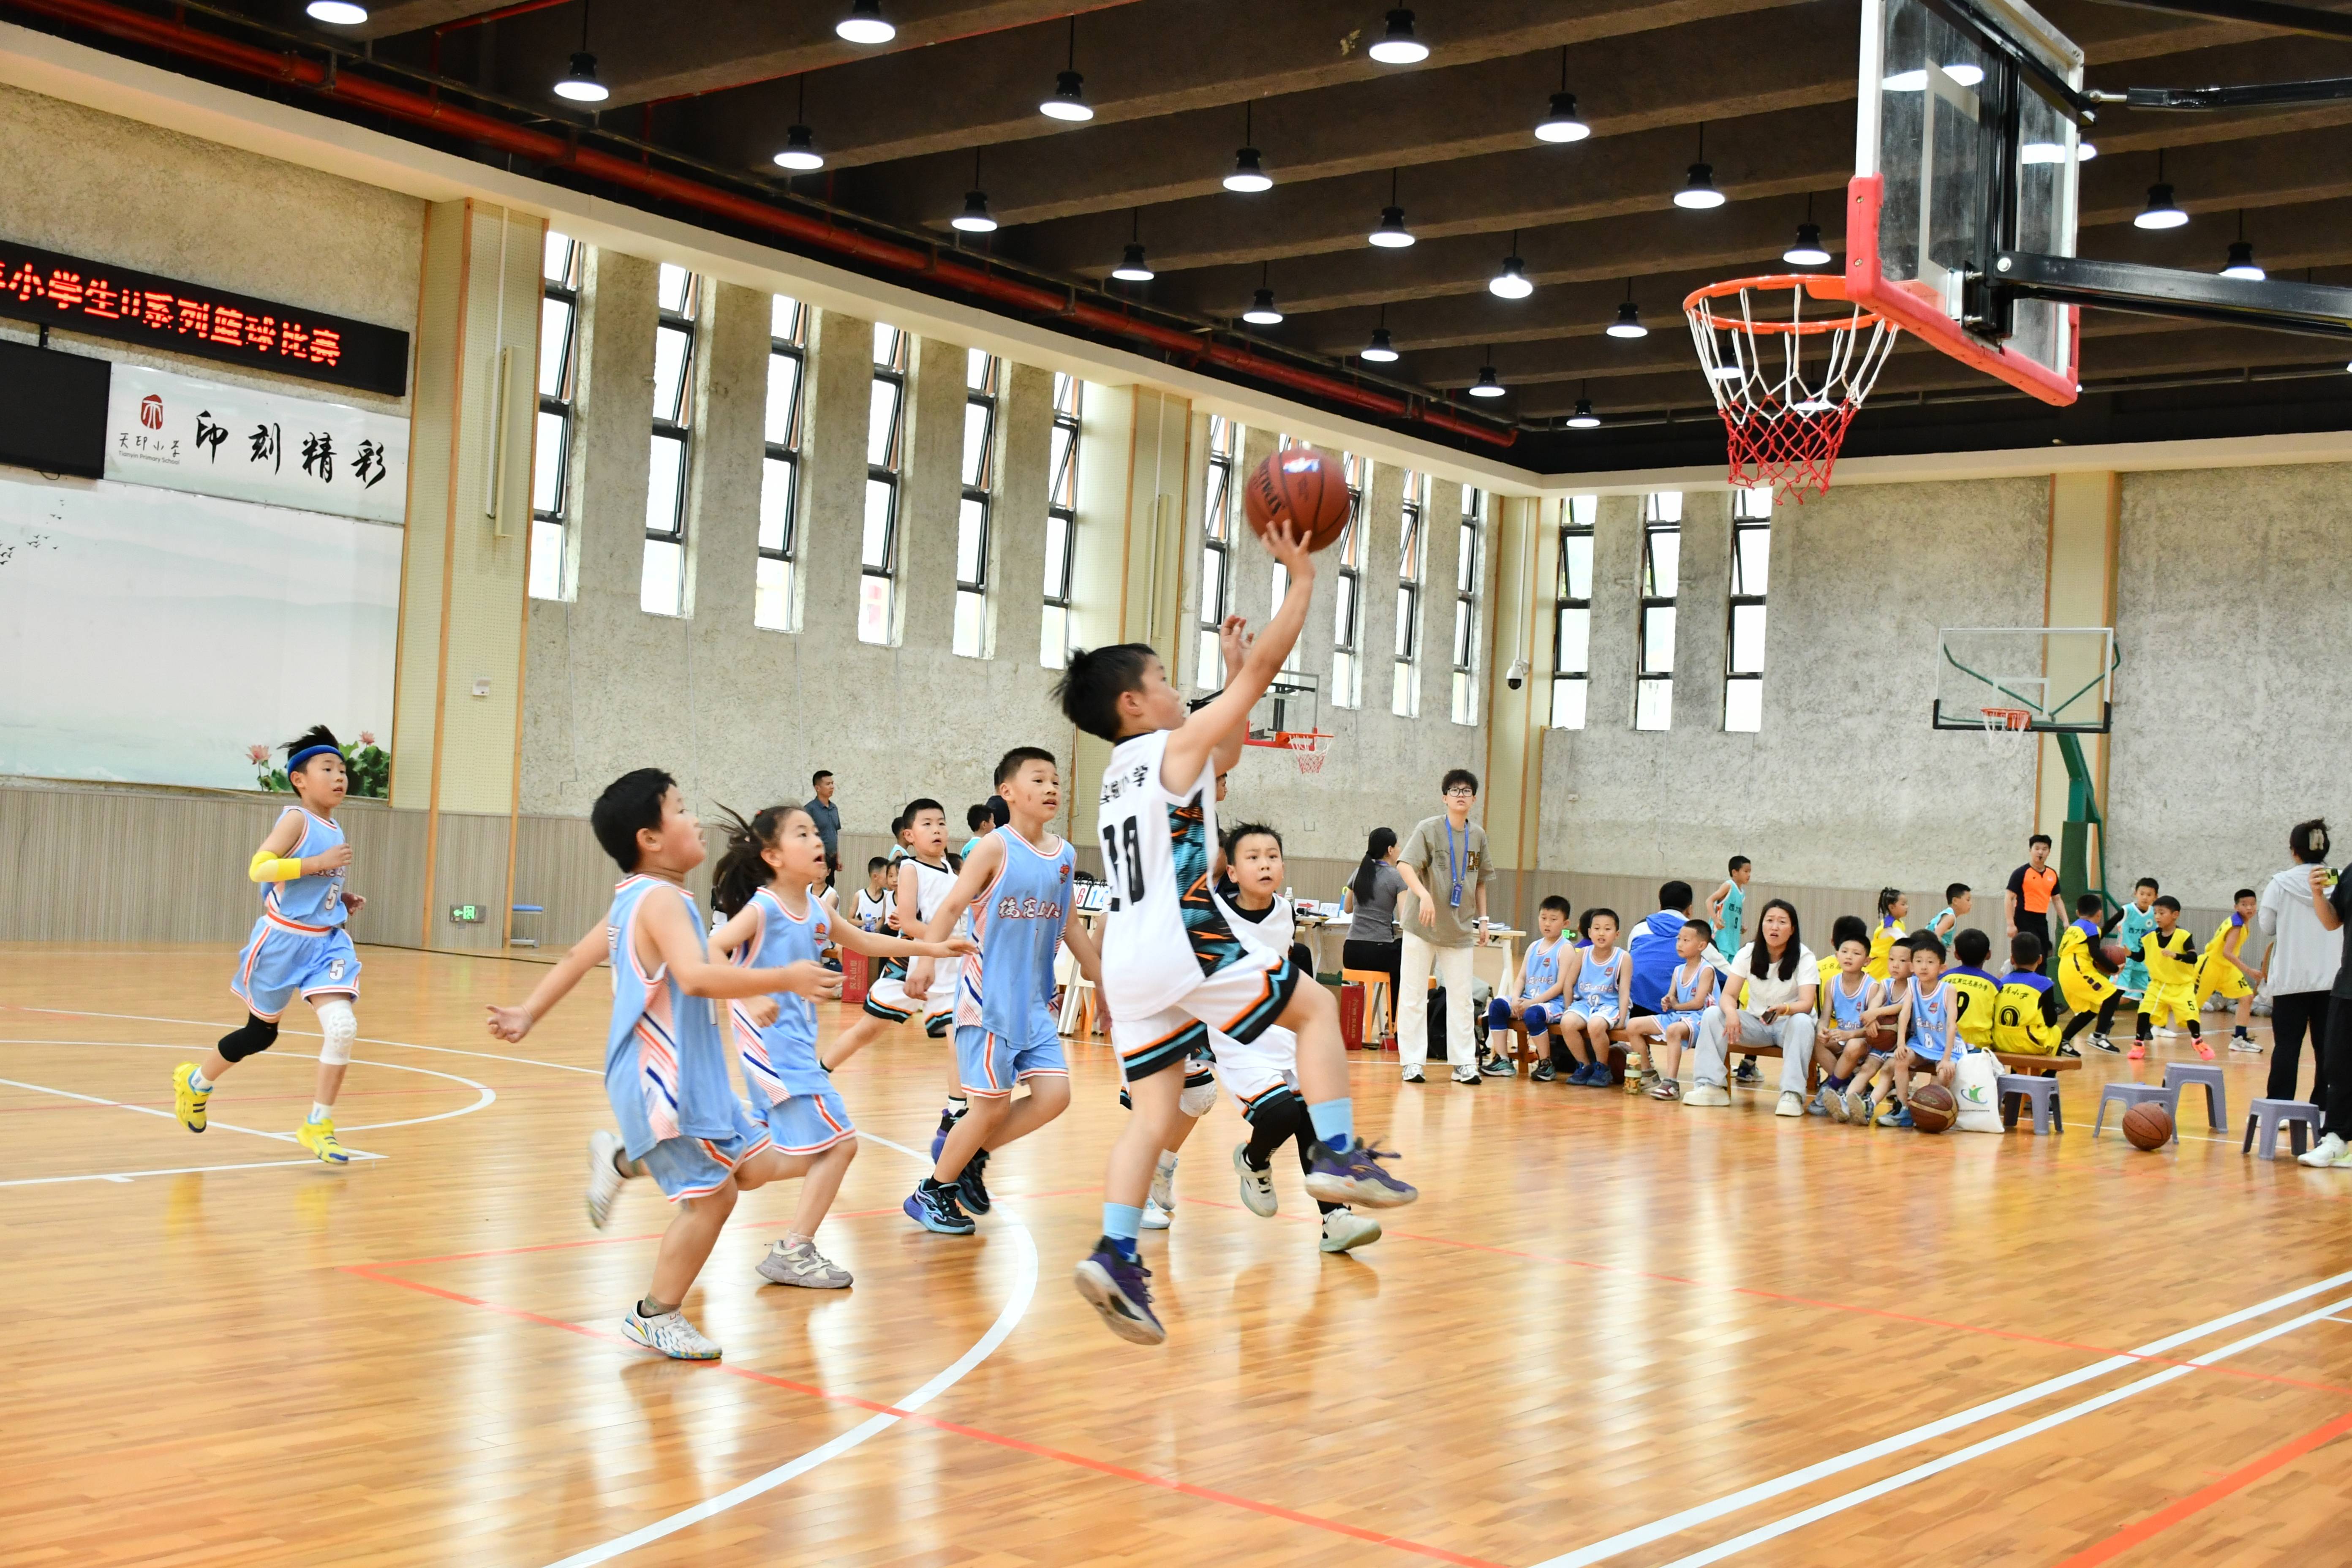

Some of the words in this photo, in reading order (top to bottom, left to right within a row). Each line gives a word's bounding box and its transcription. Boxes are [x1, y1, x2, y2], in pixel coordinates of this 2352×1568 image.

[119, 433, 180, 457] 天印小学
[196, 410, 387, 489] 印刻精彩
[119, 450, 139, 459] Tianyin
[139, 453, 161, 463] Primary
[162, 457, 180, 465] School
[324, 883, 340, 911] 5
[329, 958, 346, 980] 5
[2187, 1000, 2195, 1011] 5
[1924, 1032, 1933, 1048] 8
